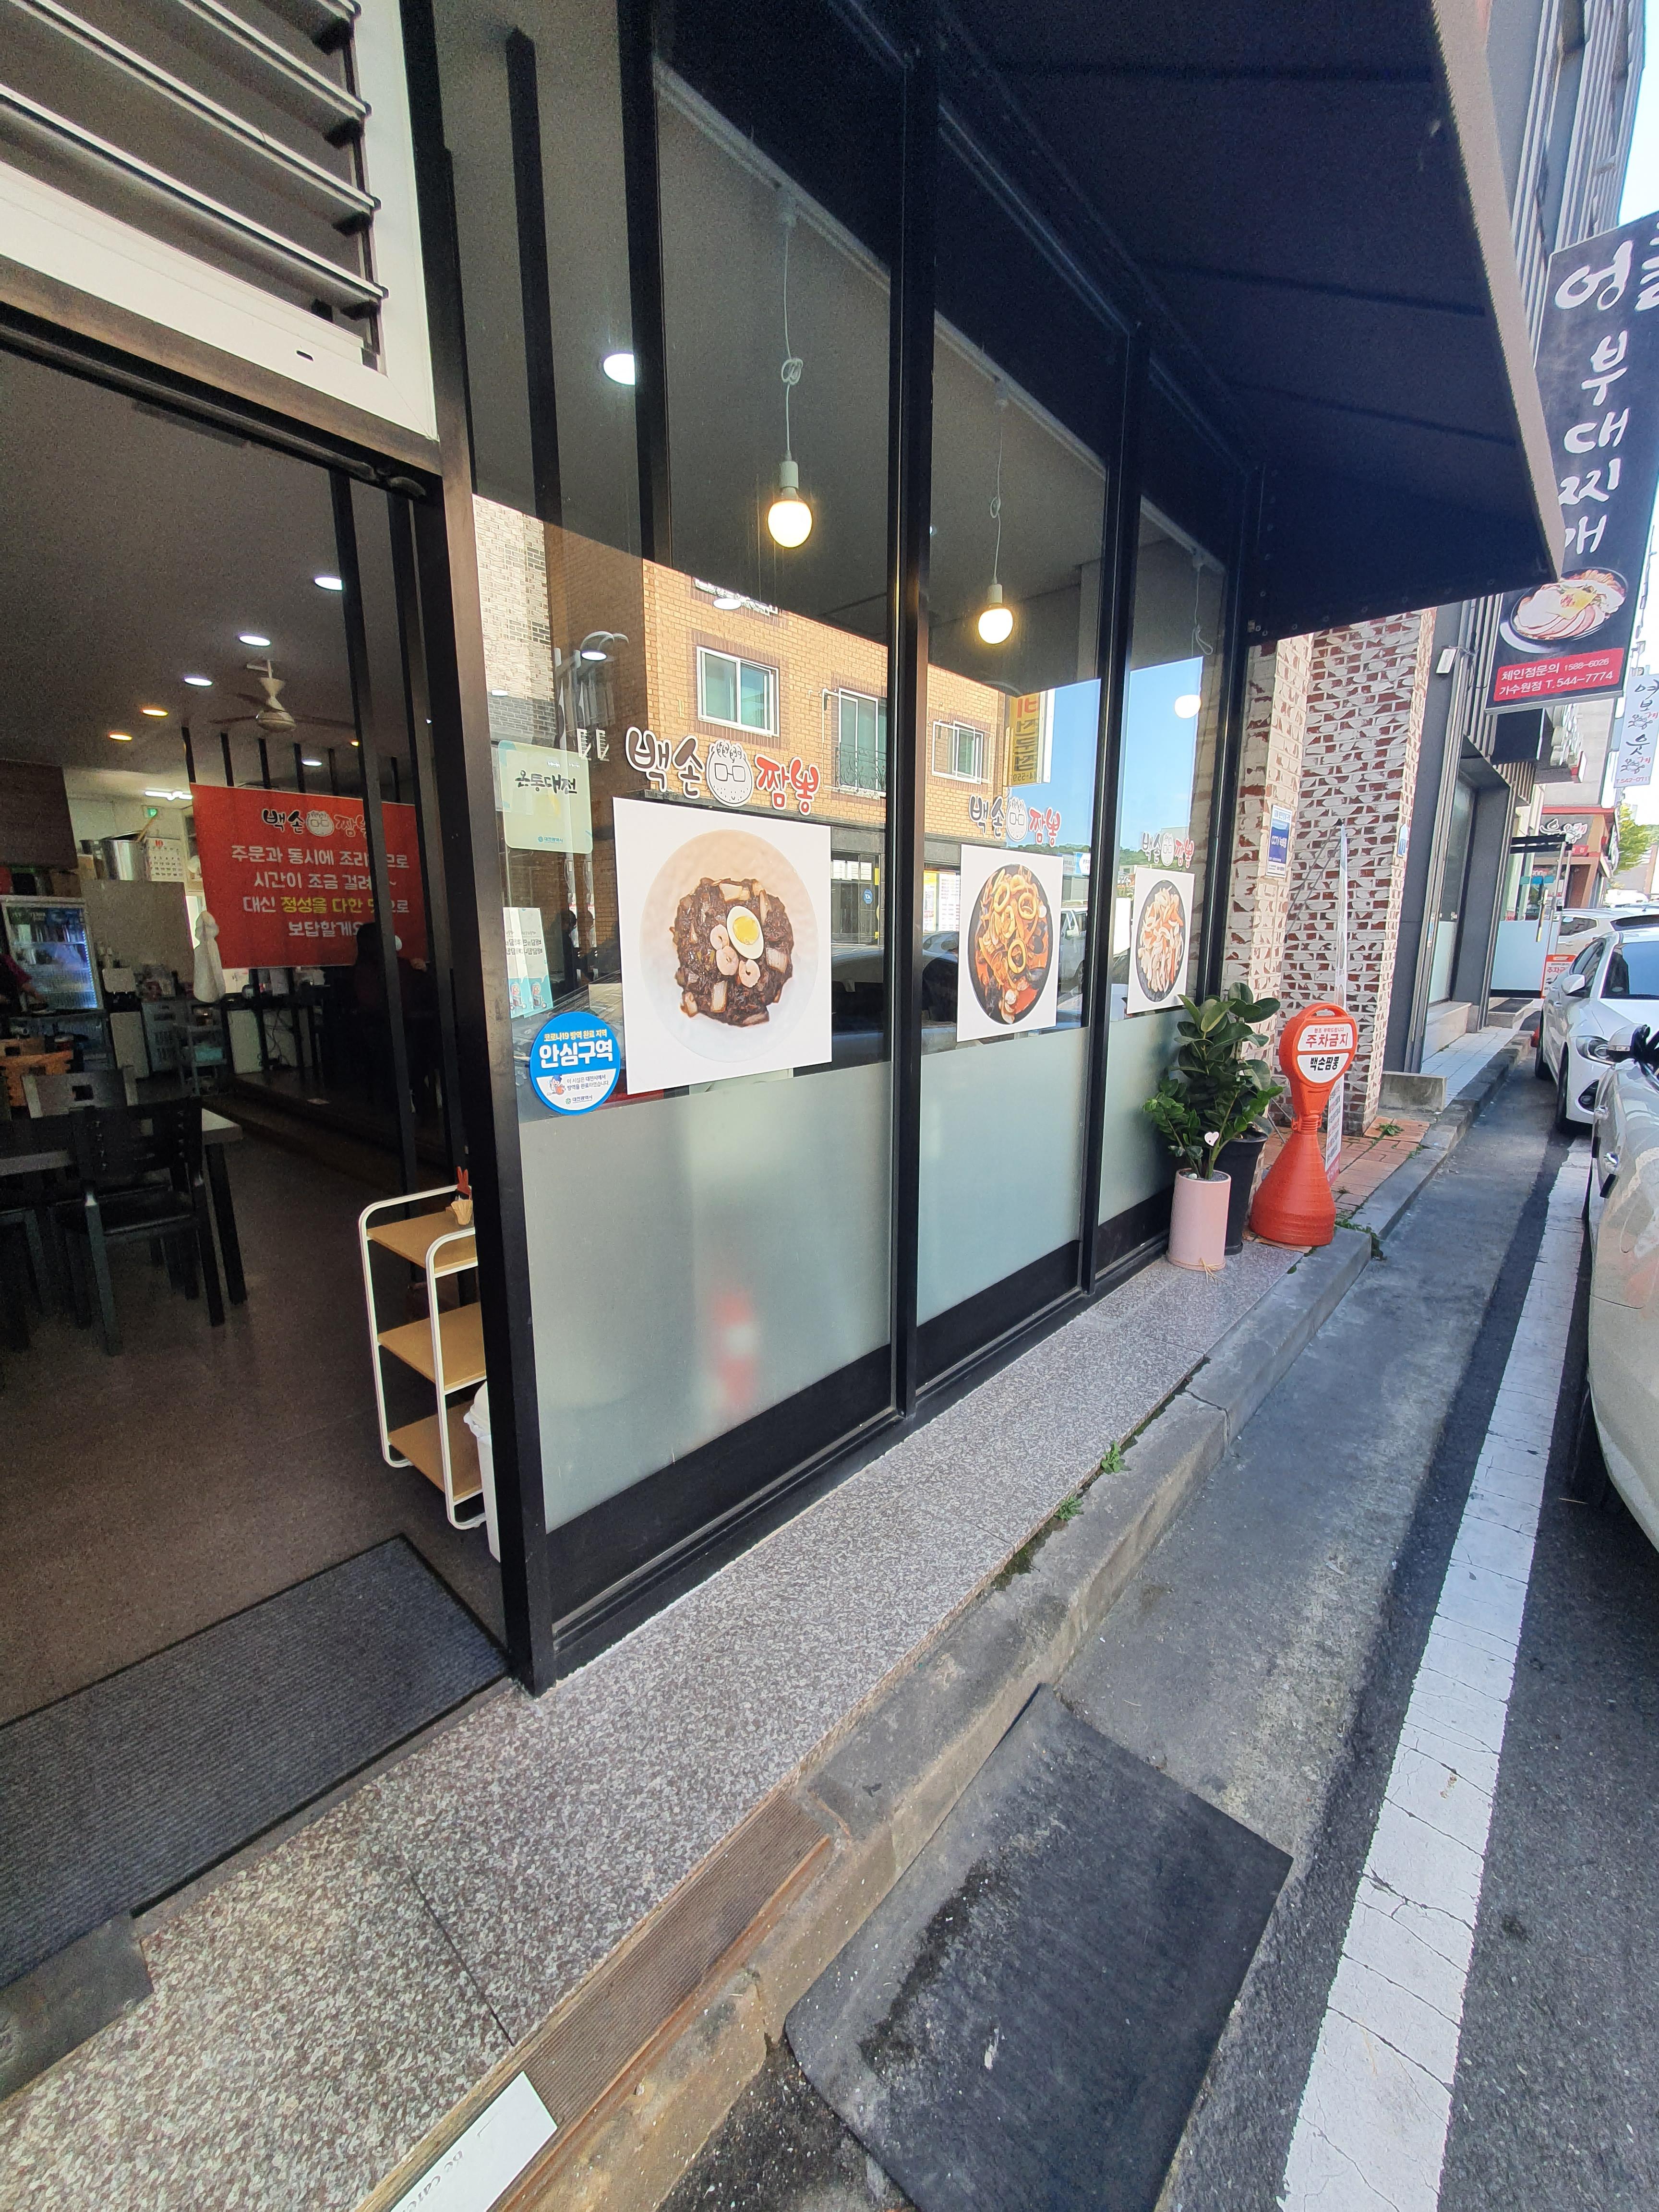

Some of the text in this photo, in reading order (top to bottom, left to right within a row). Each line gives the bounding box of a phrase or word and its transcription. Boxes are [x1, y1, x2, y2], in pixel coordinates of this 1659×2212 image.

[1558, 330, 1630, 555] 부대찌개
[1501, 663, 1560, 681] 체인점문의
[1499, 681, 1542, 696] 가수원점
[515, 770, 577, 794] 온통대전
[755, 754, 820, 815] 짬뽕
[1029, 807, 1061, 847] 짬뽕
[231, 845, 410, 868] 주문과 동시에 조리므로
[1175, 837, 1194, 868] 짬뽕
[254, 872, 302, 889] 시간이
[308, 874, 338, 890] 조금
[243, 897, 277, 913] 대신
[280, 896, 327, 914] 정성을
[332, 899, 363, 914] 다한
[544, 1029, 607, 1042] 코로나19 방역 완료 지역
[1306, 1033, 1349, 1048] 주차금지
[539, 1039, 613, 1069] 안심구역
